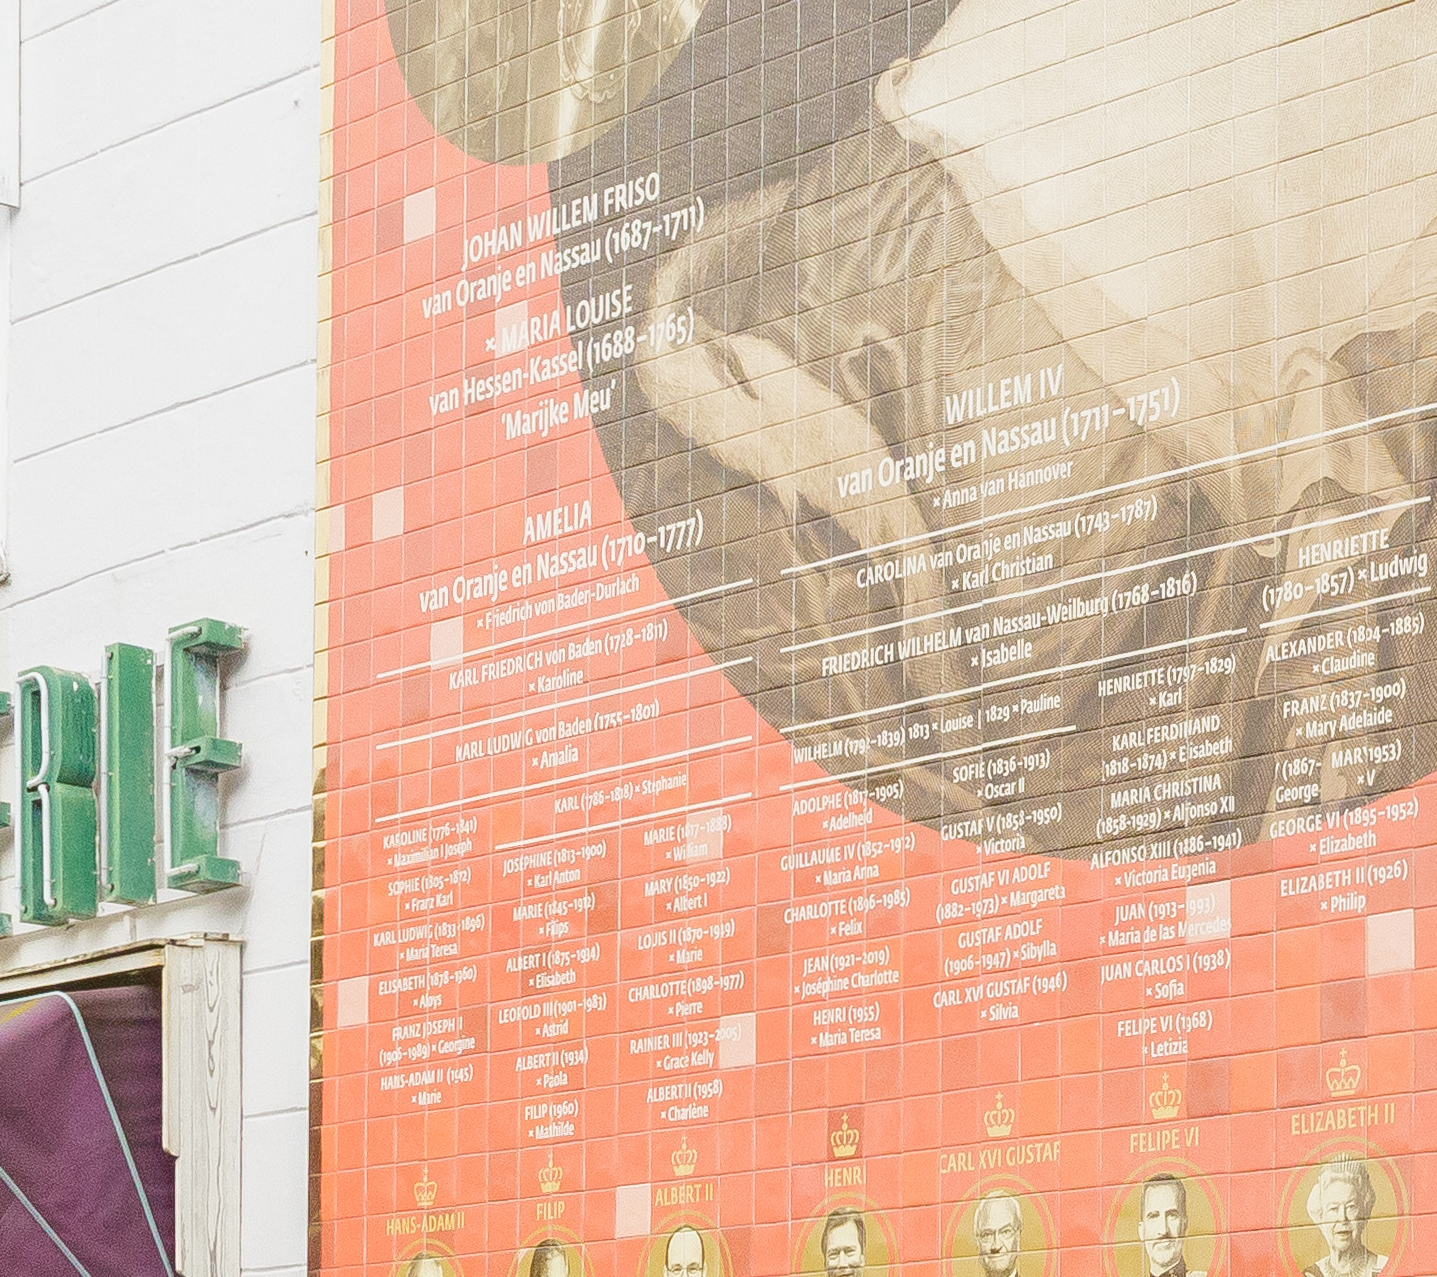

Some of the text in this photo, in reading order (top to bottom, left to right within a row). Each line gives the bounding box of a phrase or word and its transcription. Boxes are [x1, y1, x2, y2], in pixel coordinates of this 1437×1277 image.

[460, 170, 660, 272] JOHAN WILLEM FRISO
[421, 285, 452, 320] van
[455, 265, 510, 308] Oranje
[515, 258, 536, 289] en
[539, 240, 601, 281] Nassau
[501, 284, 633, 354] MARIA LOUISE
[429, 384, 459, 417] van
[463, 340, 583, 407] Hessen-Kassel
[944, 362, 1064, 426] WILLEM IV
[837, 464, 872, 499] van
[877, 444, 945, 488] Oranje
[950, 434, 976, 468] en
[981, 419, 1057, 460] Nassau
[942, 460, 1074, 511] Anna van Hannover
[522, 497, 592, 545] AMELIA
[856, 551, 927, 589] CAROLINA
[929, 549, 953, 570] van
[955, 534, 1001, 563] Oranje
[1003, 531, 1021, 552] en
[1023, 520, 1071, 547] Nassau
[1298, 526, 1389, 568] HENRIETTE
[1370, 551, 1428, 582] Ludwig
[419, 581, 449, 614] van
[452, 563, 507, 604] Oranje
[511, 559, 532, 589] en
[536, 546, 597, 582] Nassau
[962, 552, 1053, 592] Karl Christian
[485, 571, 639, 630] Friedrich von Baden-Durlach
[821, 642, 894, 678] FRIEDRICH
[898, 626, 962, 661] WILHELM
[964, 623, 990, 645] van
[992, 596, 1108, 638] Nassau-Weilburg
[981, 638, 1032, 669] Isabelle
[448, 665, 479, 692] KARL
[480, 649, 543, 683] FRIEDRICH
[545, 647, 566, 667] von
[567, 637, 602, 661] Baden
[537, 668, 584, 695] Karoline
[1129, 1125, 1199, 1155] FELIPE VI
[1290, 1102, 1395, 1134] ELIZABETH II
[823, 1163, 866, 1188] HENRI
[938, 1140, 1061, 1174] CARL XVI GUSTAF
[535, 1199, 565, 1221] FILIP
[654, 1181, 714, 1207] ALBERT II
[385, 1210, 465, 1237] HANS-ADAM II
